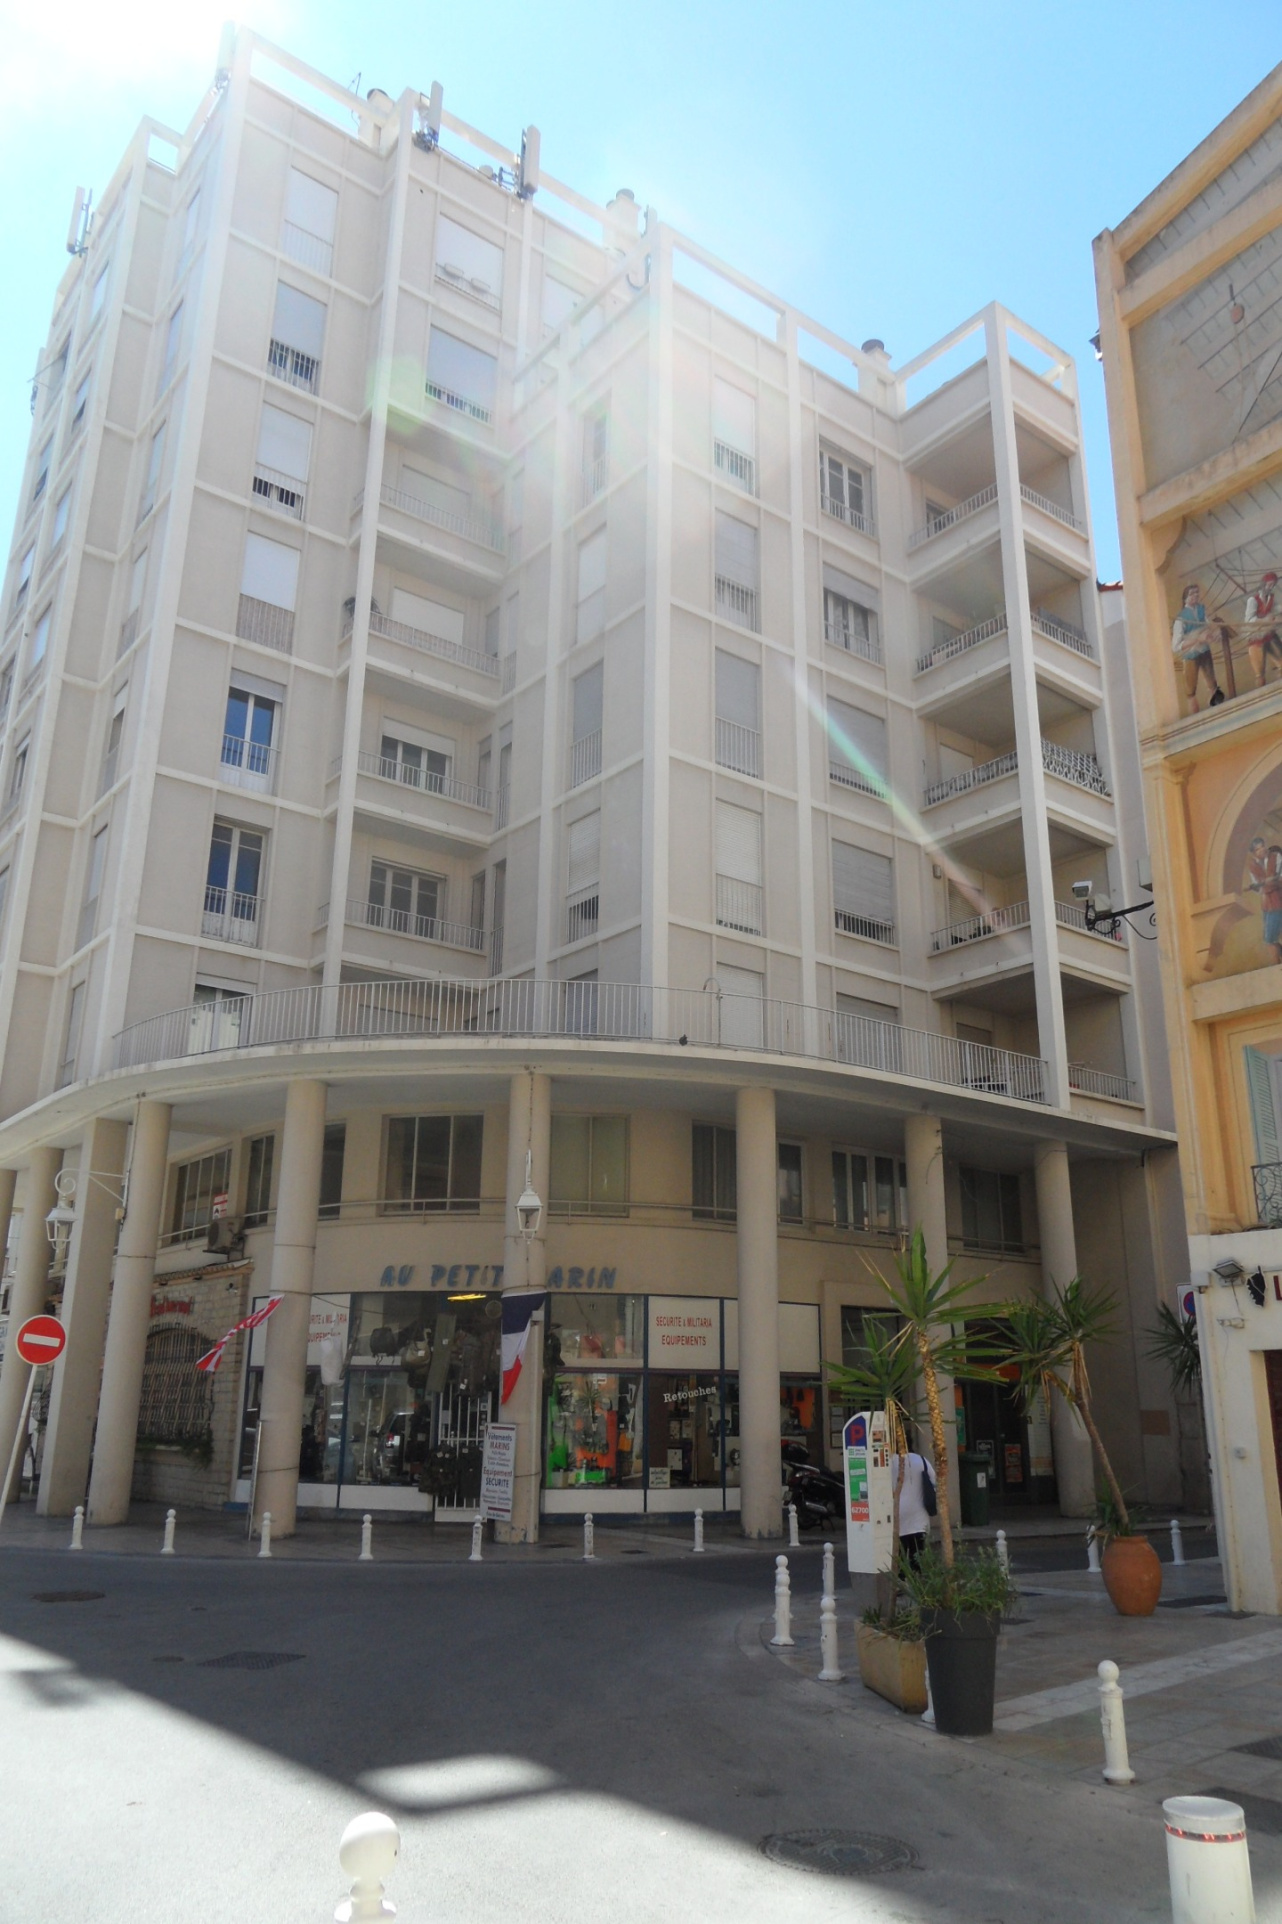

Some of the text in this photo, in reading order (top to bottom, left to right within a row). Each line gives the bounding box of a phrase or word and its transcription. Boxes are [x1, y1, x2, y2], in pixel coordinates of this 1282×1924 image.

[380, 1264, 617, 1290] AU PETIT ARIN
[655, 1316, 682, 1327] SECURITE
[687, 1317, 713, 1328] MILITARIA
[663, 1386, 717, 1403] Retouches
[849, 1425, 864, 1446] P
[485, 1477, 509, 1489] SECURITE
